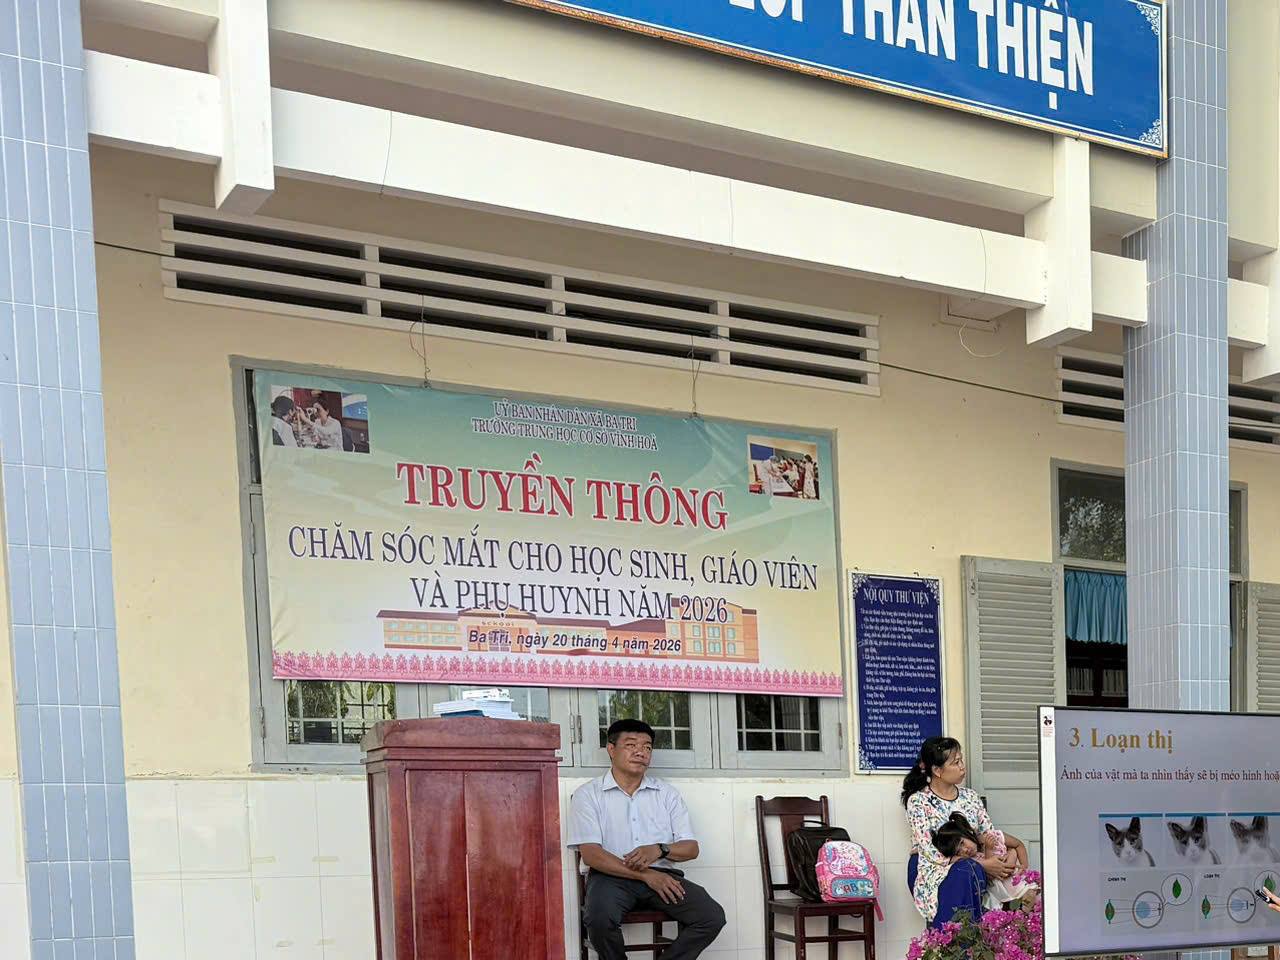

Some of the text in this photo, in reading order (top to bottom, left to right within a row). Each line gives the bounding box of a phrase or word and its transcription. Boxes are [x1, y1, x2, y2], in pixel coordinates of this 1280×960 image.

[968, 0, 1095, 110] THIỆN
[511, 402, 533, 419] BAN
[534, 404, 565, 424] NHÂN
[566, 407, 588, 426] DÂN
[589, 410, 605, 428] XÃ
[605, 414, 619, 430] BA
[620, 416, 638, 431] TRI
[472, 417, 517, 437] TRƯỜNG
[518, 422, 554, 441] TRUNG
[556, 428, 578, 445] HỌC
[395, 452, 729, 531] TRUYỀN THÔNG
[288, 521, 818, 591] CHĂM SÓC MẮT CHO HỌC SINH, GIÁO VIÊN
[410, 570, 728, 624] VÀ PHỤ HUYNH NĂM 2026
[863, 586, 929, 608] NỘI QUY THƯ VIỆN
[469, 630, 486, 644] Ba
[516, 632, 549, 648] ngày
[552, 633, 568, 647] 20
[571, 634, 607, 651] tháng
[611, 636, 619, 648] 4
[622, 636, 648, 650] năm
[653, 639, 681, 651] 2026
[1069, 727, 1084, 748] 3.
[1091, 728, 1141, 753] Loạn
[1148, 730, 1173, 754] thị
[1061, 764, 1082, 780] Ảnh
[1085, 768, 1102, 780] của
[1105, 768, 1120, 782] vật
[1123, 769, 1138, 780] mà
[1140, 770, 1149, 780] ta
[1152, 768, 1173, 780] nhìn
[1175, 767, 1195, 783] thấy
[1210, 769, 1219, 782] bị
